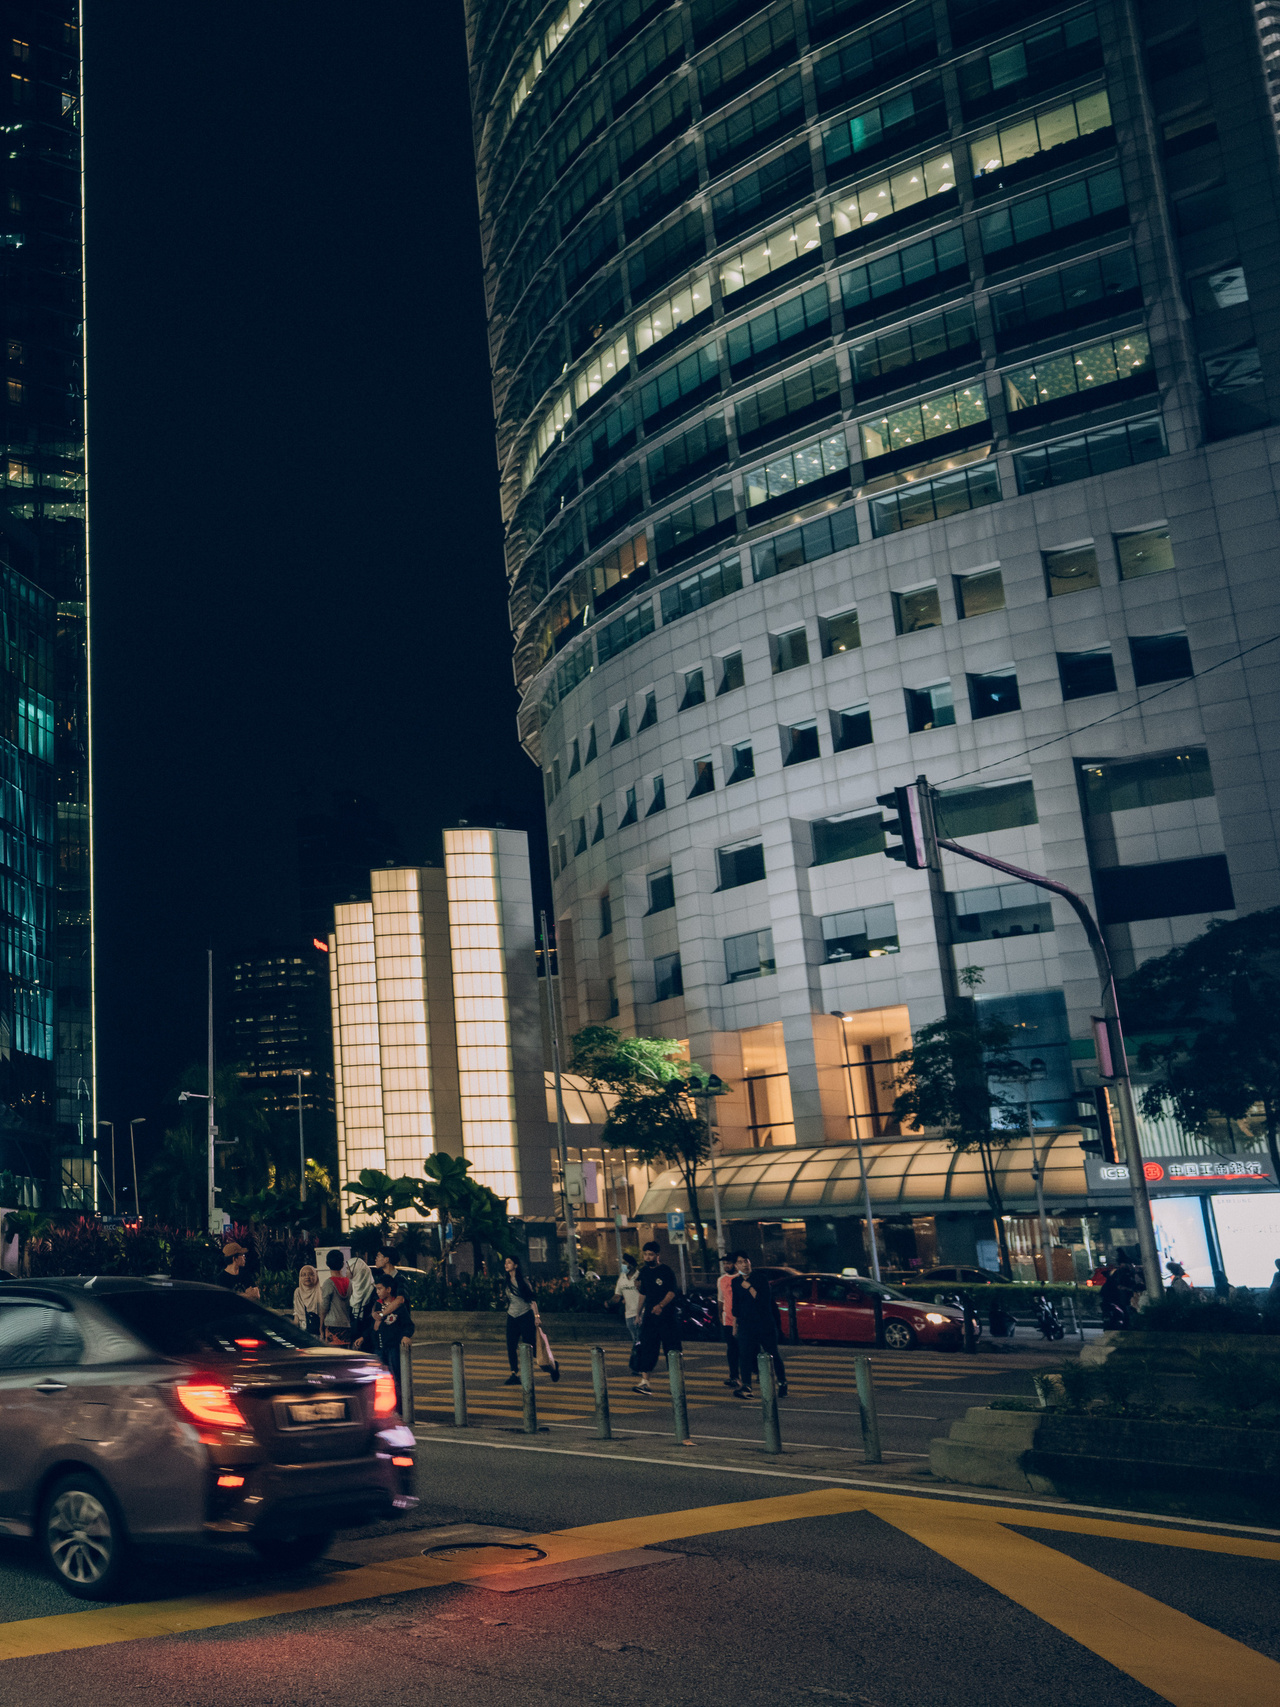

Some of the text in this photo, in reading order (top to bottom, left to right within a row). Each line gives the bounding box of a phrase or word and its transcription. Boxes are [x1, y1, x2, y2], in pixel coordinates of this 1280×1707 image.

[1100, 1166, 1129, 1180] ICB
[1169, 1161, 1261, 1176] 中国工商银行
